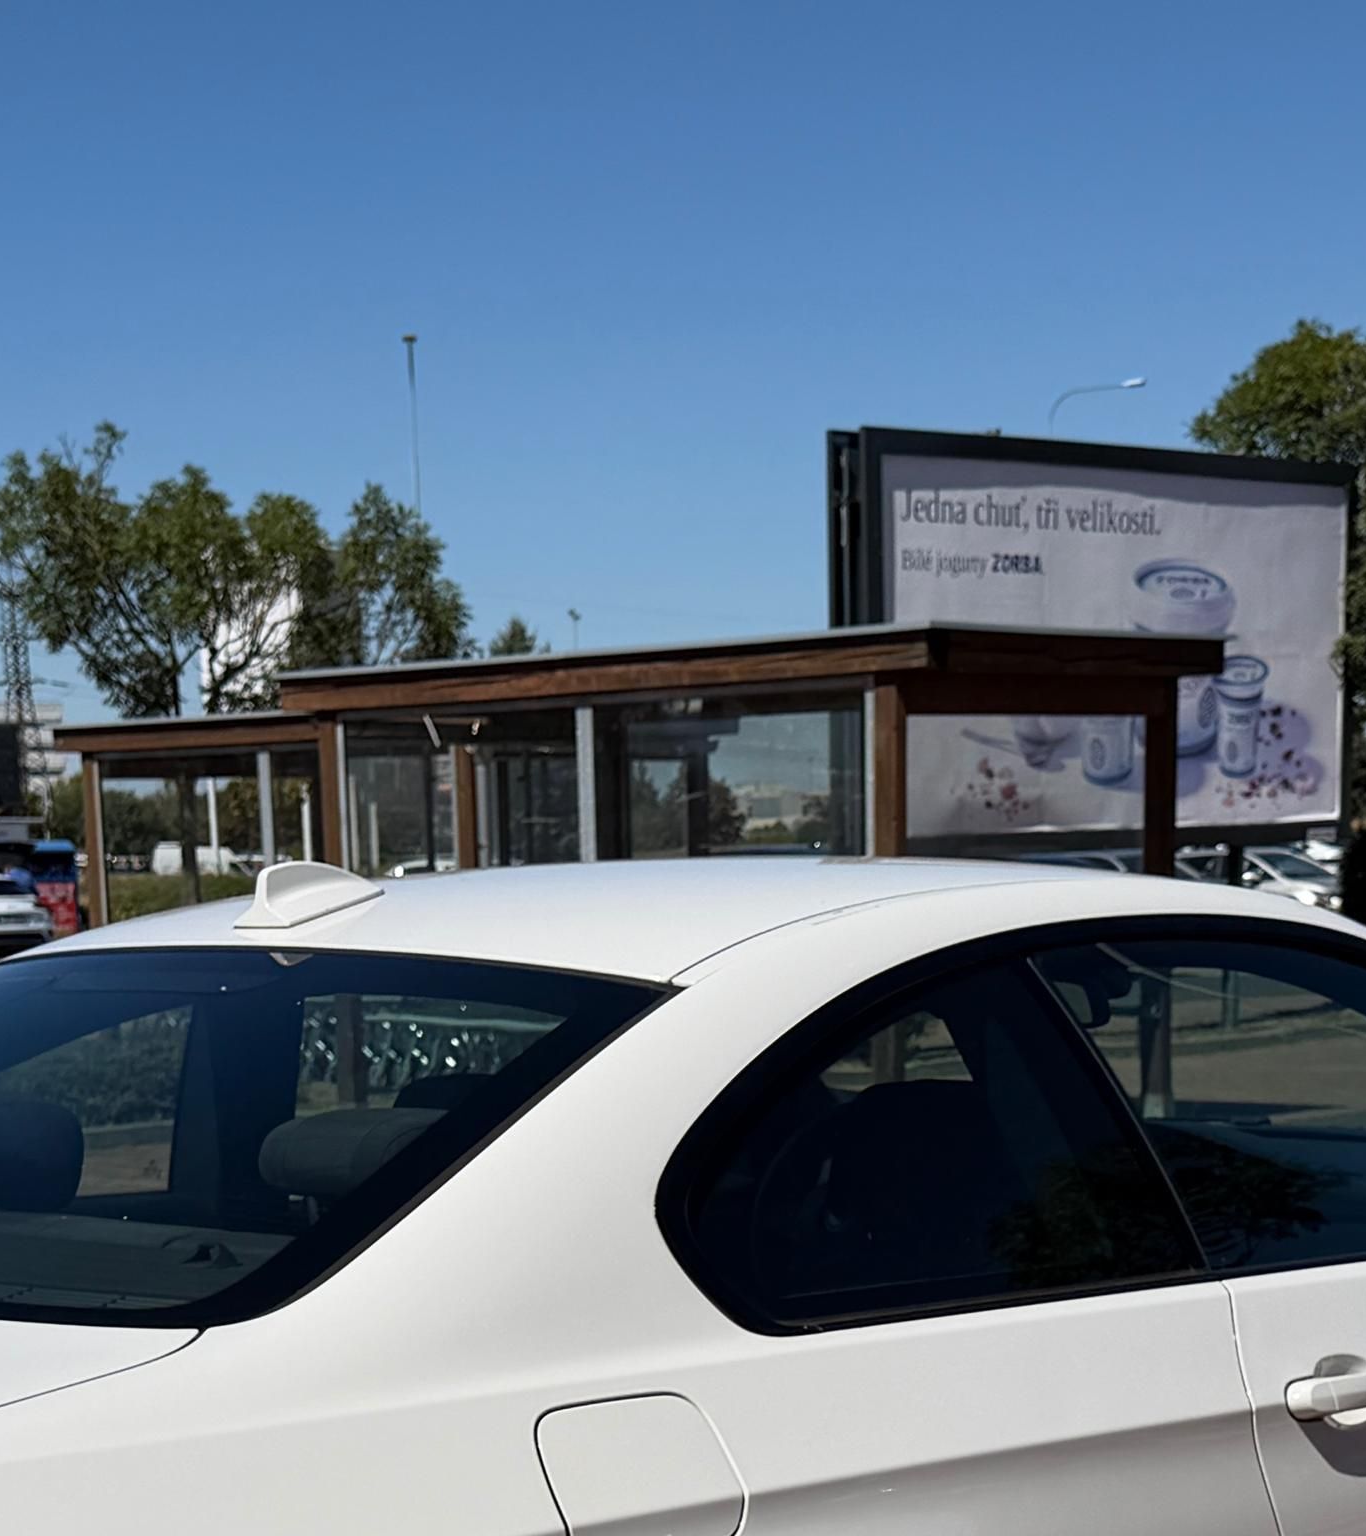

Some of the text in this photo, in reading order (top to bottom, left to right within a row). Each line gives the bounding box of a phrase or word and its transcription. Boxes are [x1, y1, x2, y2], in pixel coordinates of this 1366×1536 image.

[900, 488, 1163, 536] Jedna chuť, tři velikosti.
